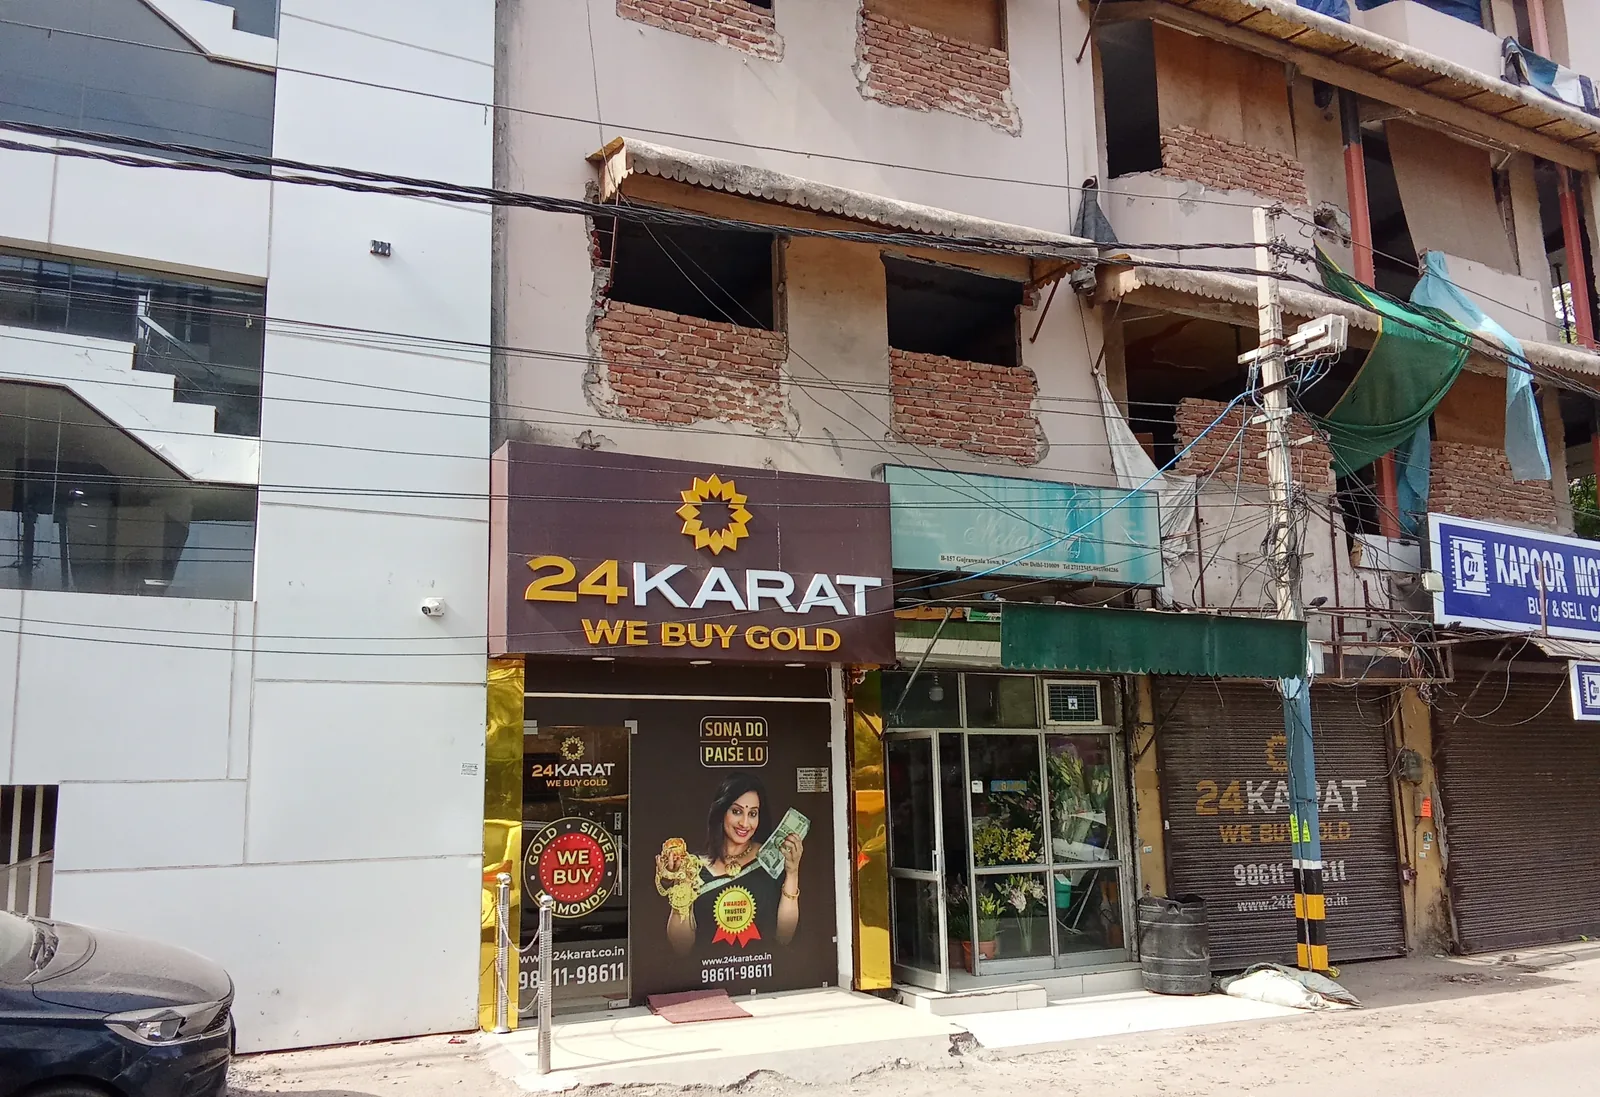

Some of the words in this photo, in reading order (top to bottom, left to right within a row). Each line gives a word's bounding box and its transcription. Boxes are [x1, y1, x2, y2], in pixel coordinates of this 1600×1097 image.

[1493, 543, 1569, 594] KAPOOR
[1573, 555, 1600, 598] MO
[524, 555, 882, 616] 24KARAT
[1552, 600, 1561, 618] &
[1561, 600, 1587, 621] SELL
[1590, 604, 1600, 622] C
[581, 618, 650, 646] WE
[660, 621, 738, 649] BUY
[745, 625, 841, 652] GOLD
[705, 721, 742, 737] SONA
[745, 721, 763, 737] DO
[705, 746, 744, 762] PAISE
[747, 746, 764, 762] LO
[531, 763, 615, 777] 24KARAT
[545, 779, 561, 787] WE
[563, 779, 582, 787] BUY
[583, 779, 608, 787] GOLD
[580, 822, 615, 863] SILVER
[1219, 823, 1252, 844] WE
[528, 827, 558, 866] GOLD
[557, 849, 590, 865] WE
[553, 867, 594, 885] BUY
[534, 886, 607, 915] DAMONDS
[702, 952, 772, 966] www.24karat.co.in
[518, 962, 624, 990] 9811-98611
[701, 963, 773, 983] 98611-98611
